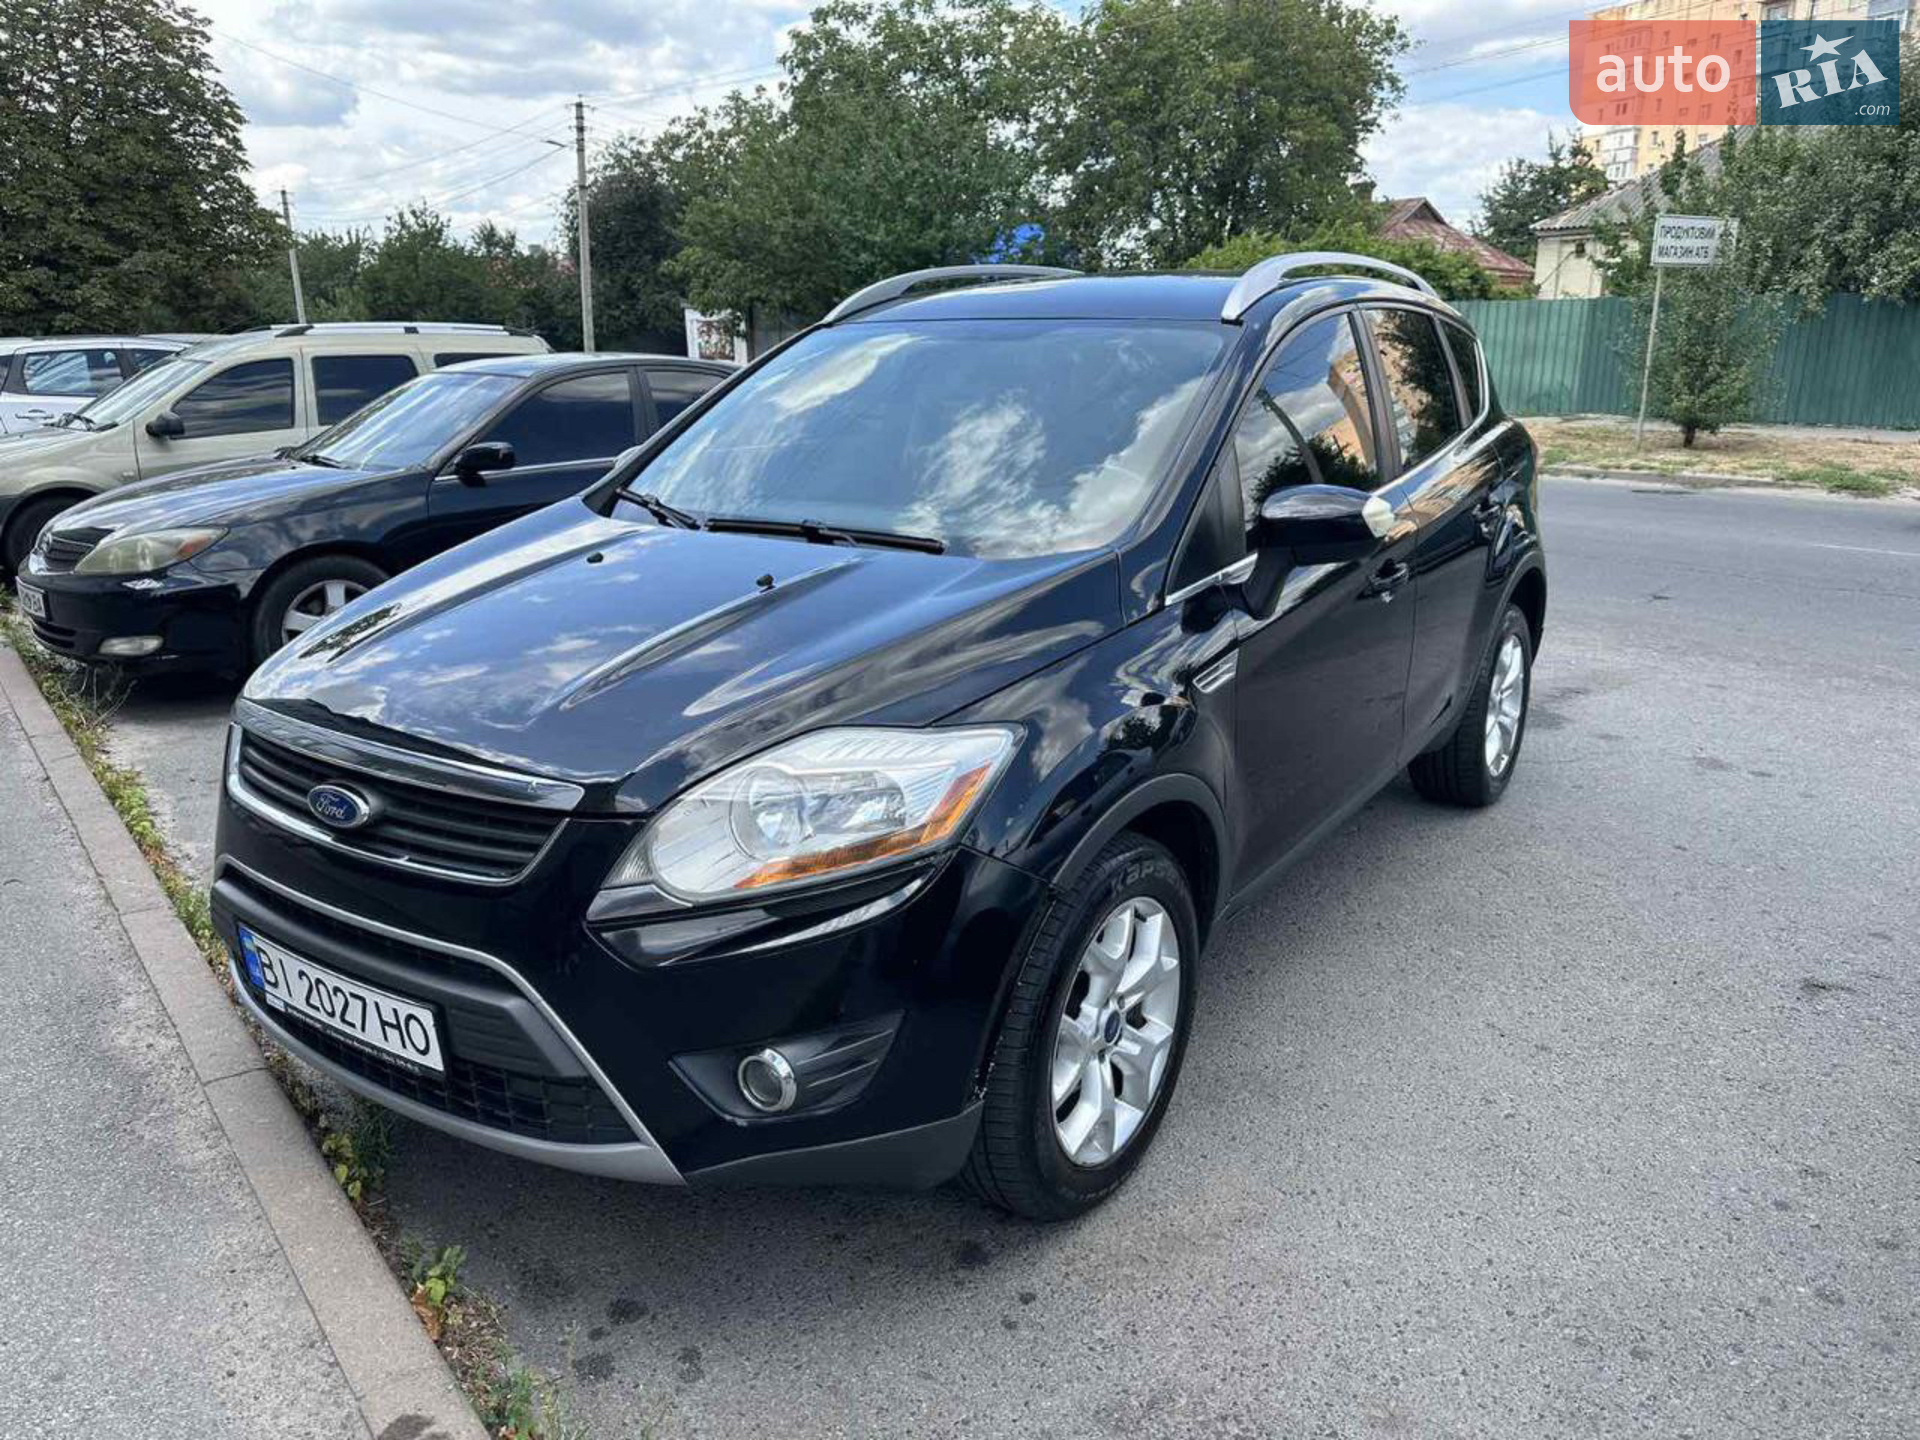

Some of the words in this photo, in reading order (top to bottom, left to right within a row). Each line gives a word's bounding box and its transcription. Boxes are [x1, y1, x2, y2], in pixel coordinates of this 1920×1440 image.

[1658, 245, 1694, 259] МАГАЗИН
[1695, 245, 1709, 259] АТБ
[315, 791, 350, 820] Ford
[256, 946, 293, 998] BI
[298, 969, 367, 1033] 2027
[375, 1001, 431, 1057] HO
